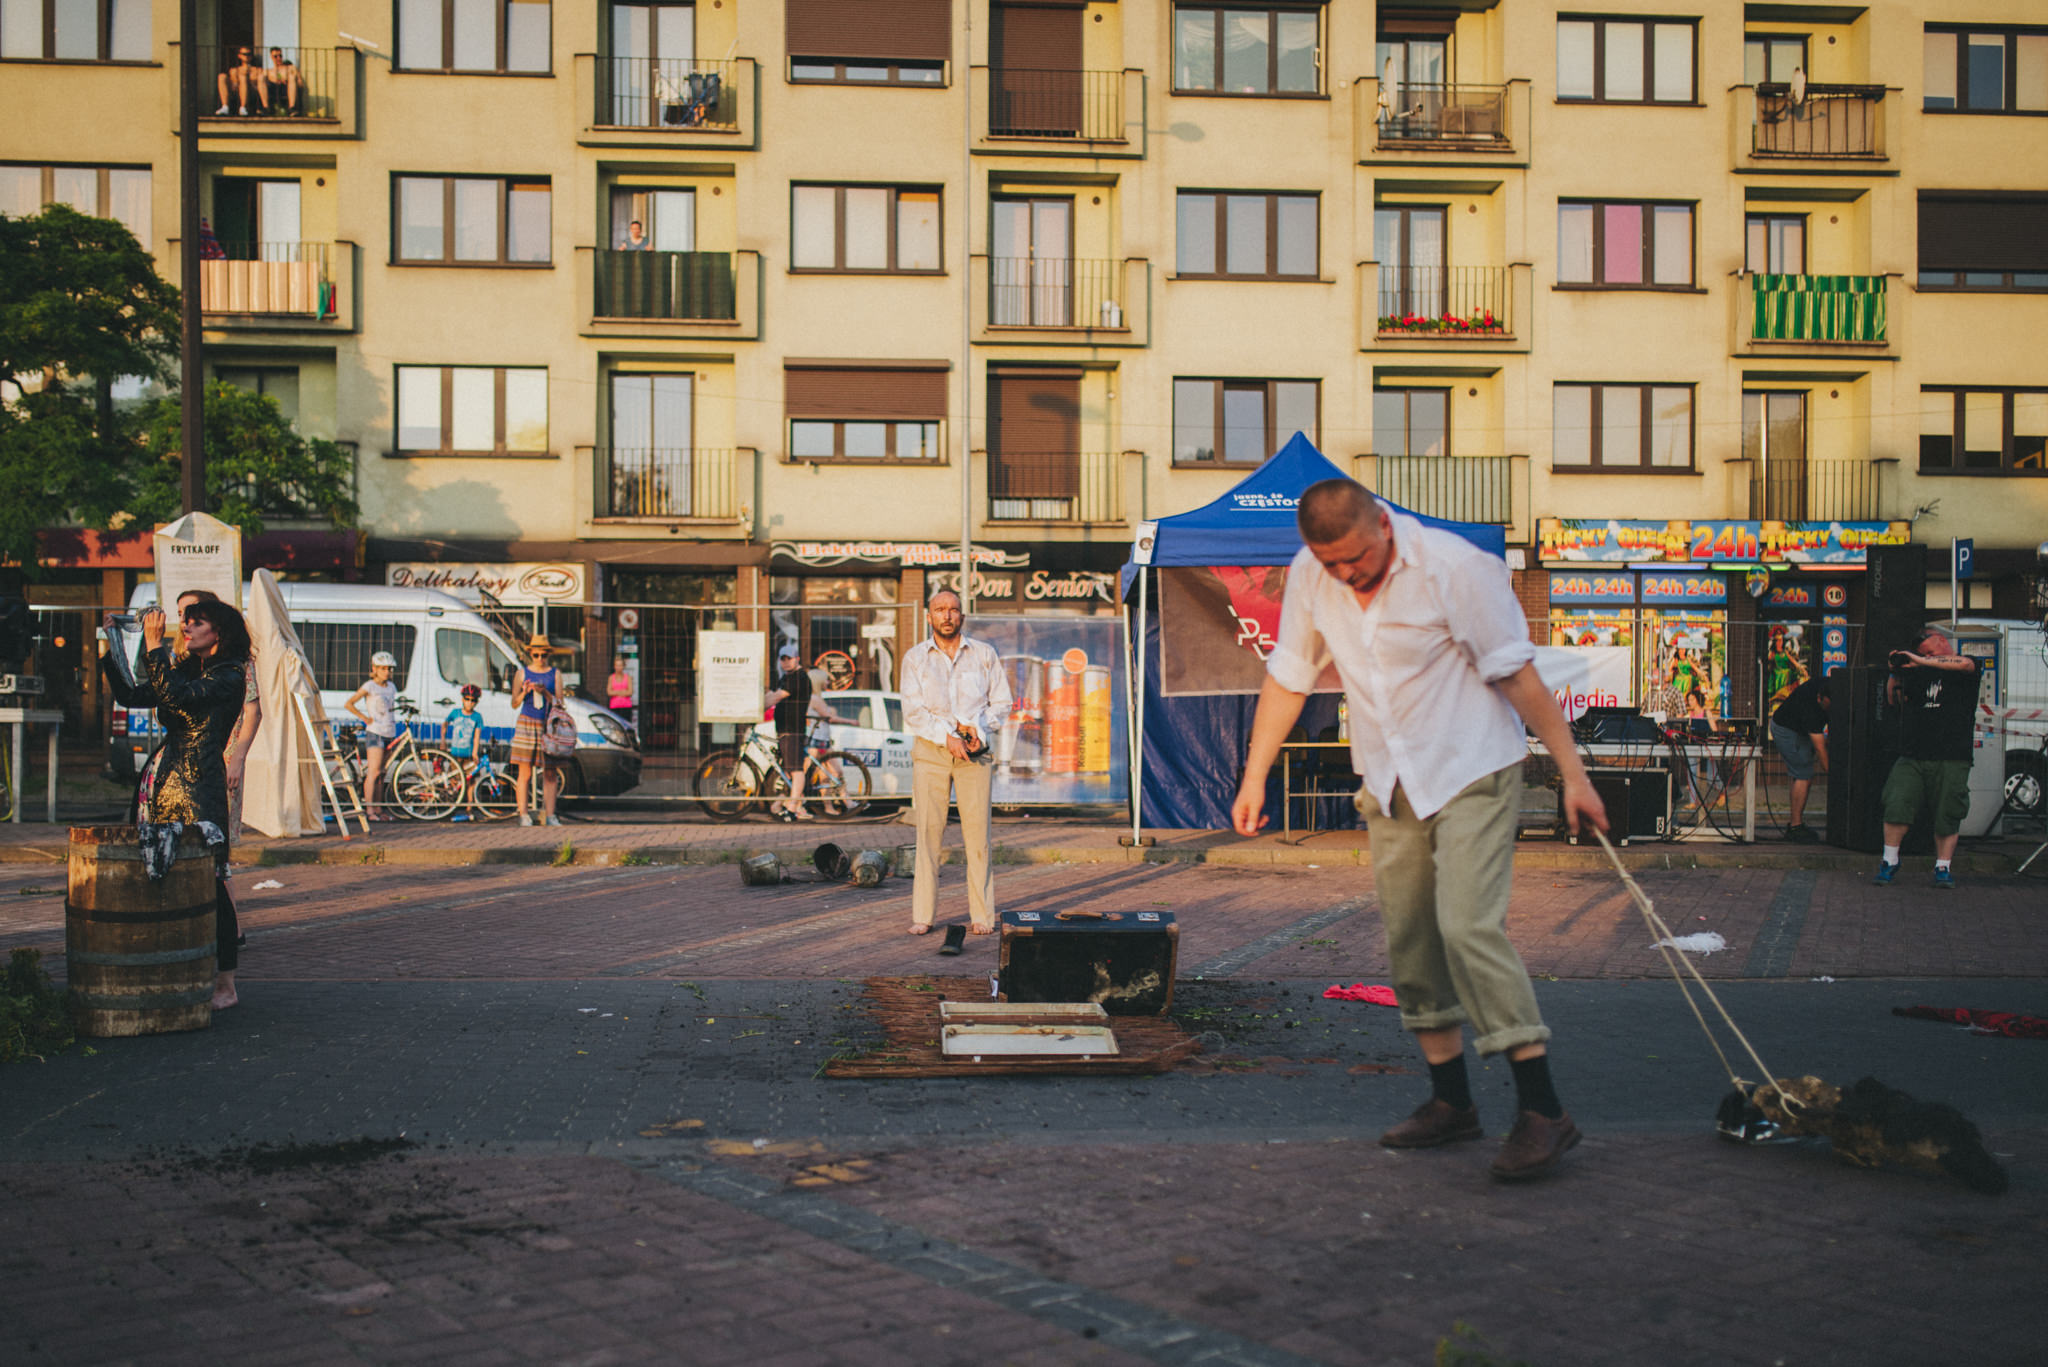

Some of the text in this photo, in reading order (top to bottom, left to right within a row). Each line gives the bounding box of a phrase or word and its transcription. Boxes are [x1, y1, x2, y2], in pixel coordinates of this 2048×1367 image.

[171, 544, 220, 554] FRYTKA OFF
[1543, 526, 1684, 557] LUCKY QUEEN
[1692, 525, 1757, 559] 24h
[1766, 529, 1832, 557] LUCKY
[901, 550, 1007, 566] papieosy
[1959, 547, 1970, 571] P
[951, 570, 1098, 600] Don Senior
[1552, 578, 1633, 596] 24h 24h
[1644, 579, 1726, 597] 24h 24h
[1771, 587, 1809, 604] 24h
[1828, 590, 1842, 600] 18
[1823, 616, 1848, 625] 24h
[1823, 651, 1848, 663] 24h
